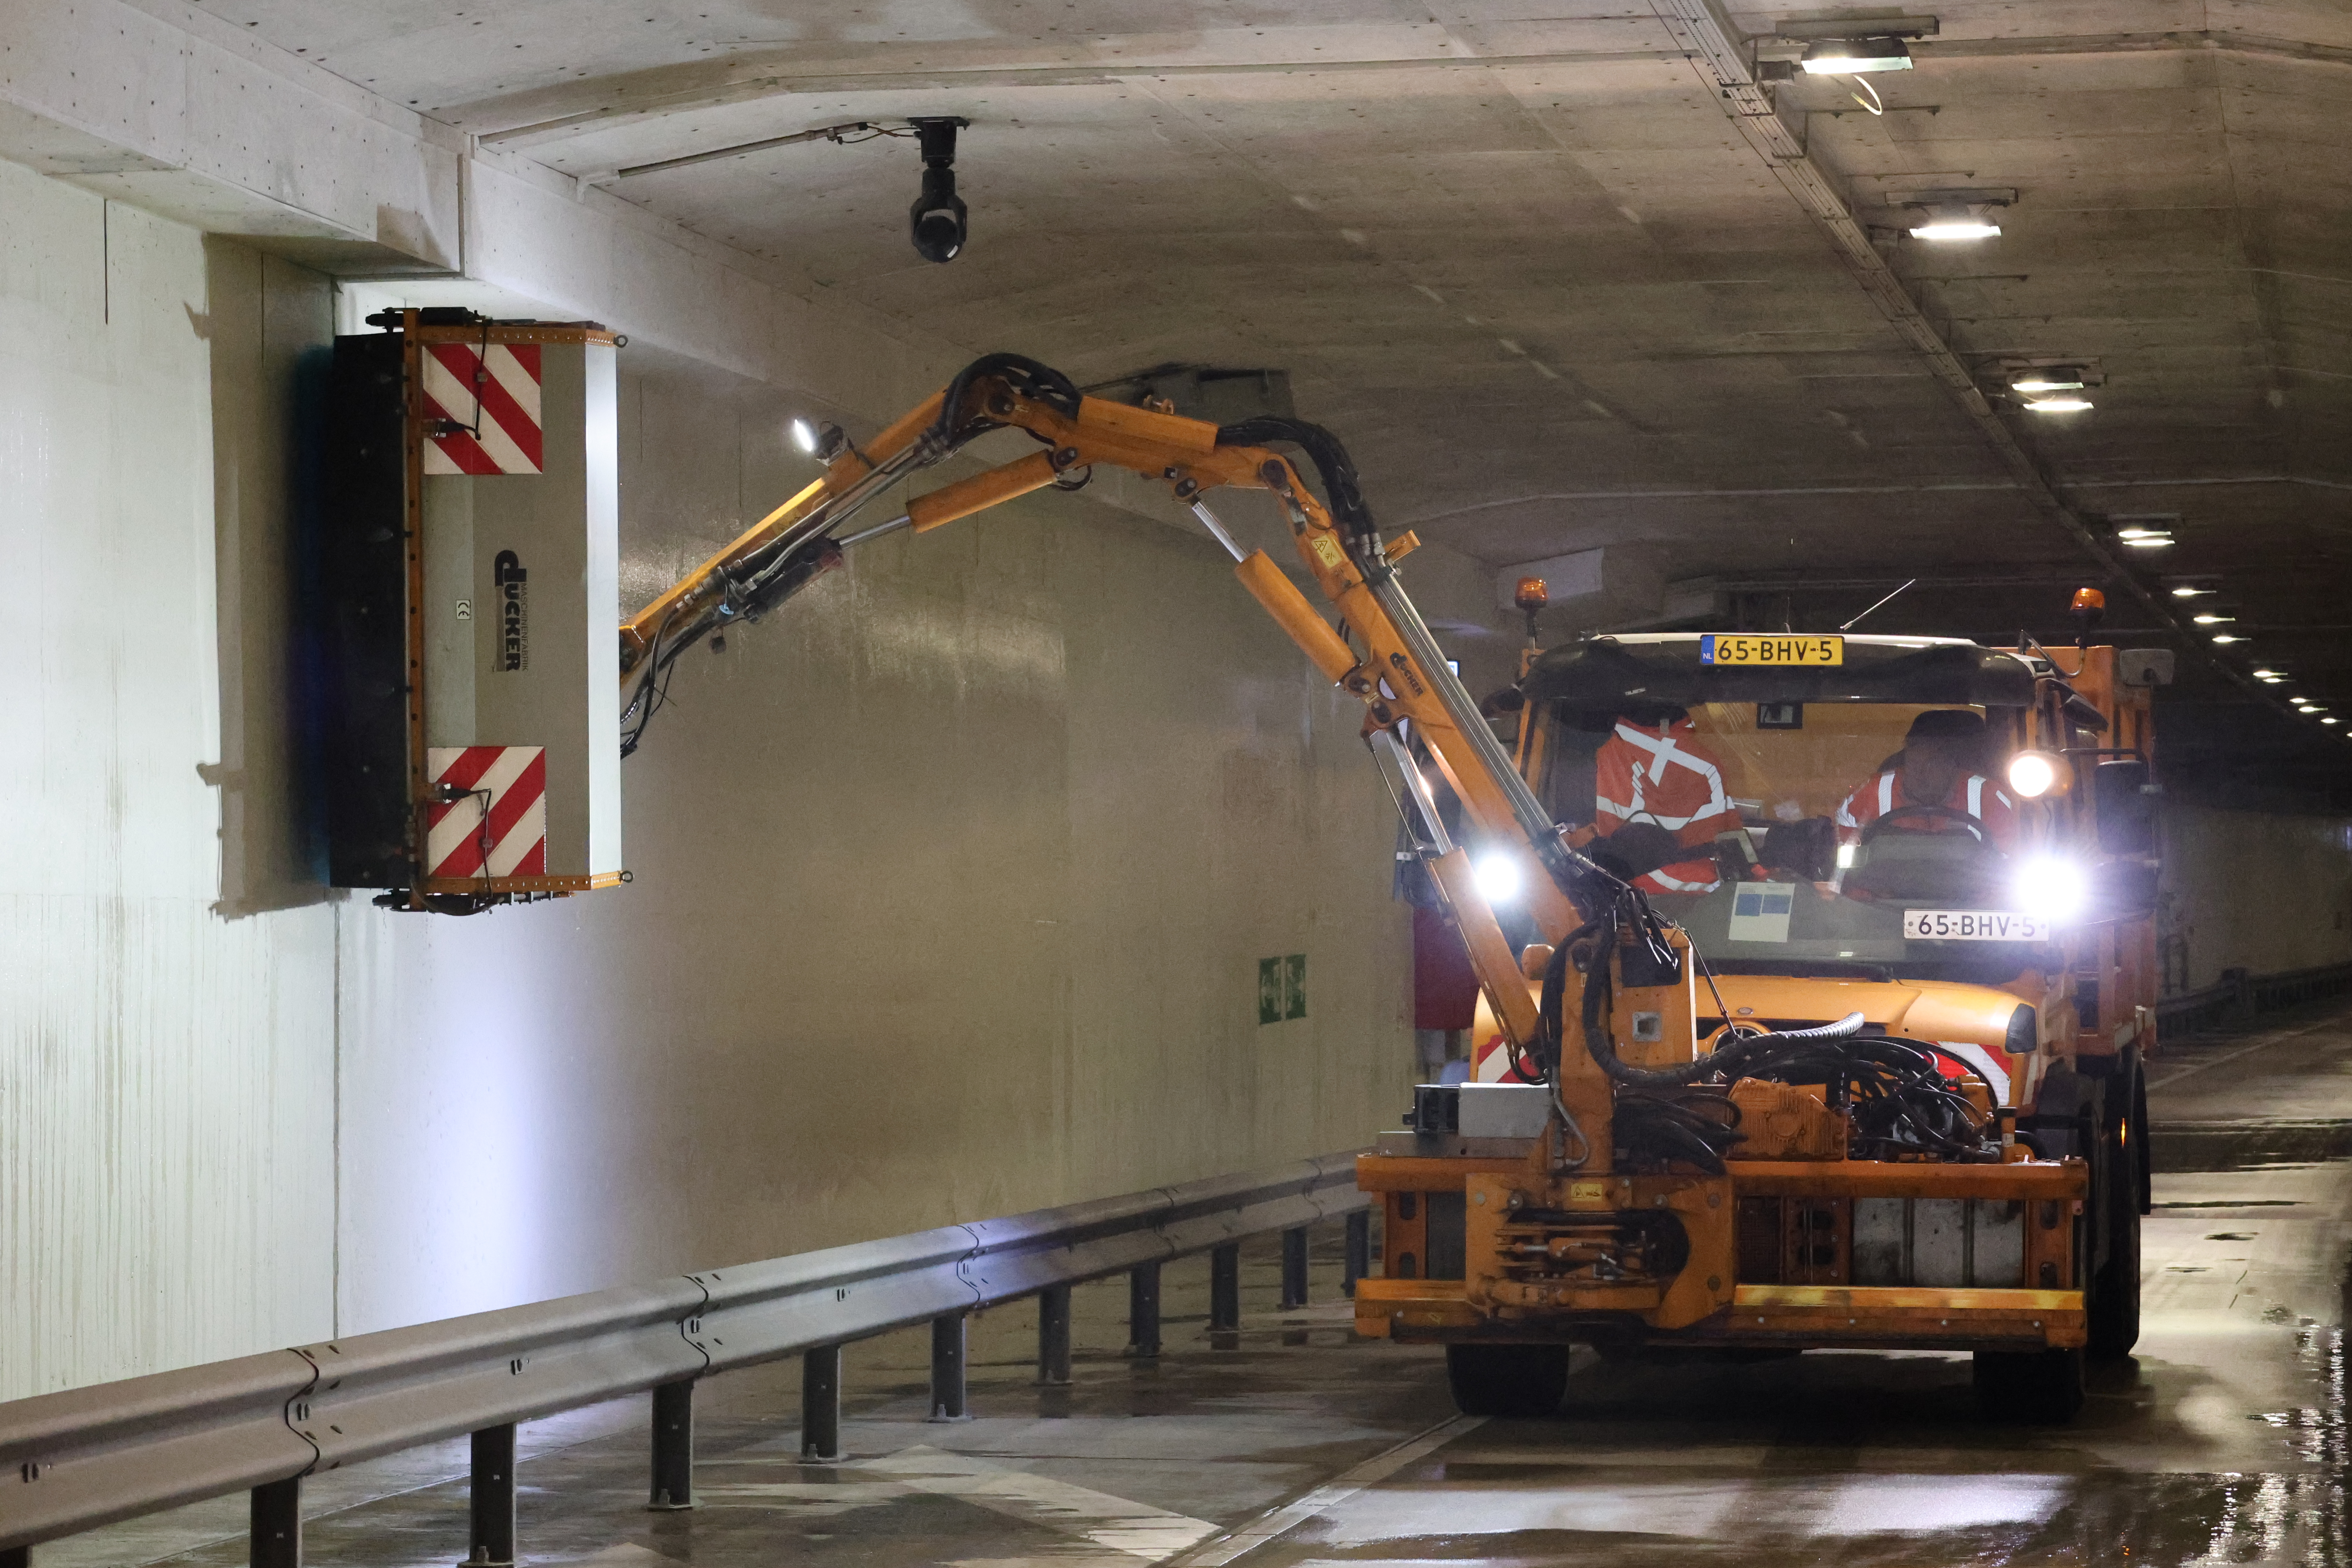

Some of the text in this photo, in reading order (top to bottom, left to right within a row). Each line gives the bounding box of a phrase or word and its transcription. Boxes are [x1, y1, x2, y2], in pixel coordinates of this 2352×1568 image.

[458, 602, 468, 617] CE
[520, 583, 529, 671] MASCHINENFABRIK
[1719, 641, 1832, 661] 65-BHV-5
[1918, 915, 2035, 937] 65-BHV-5
